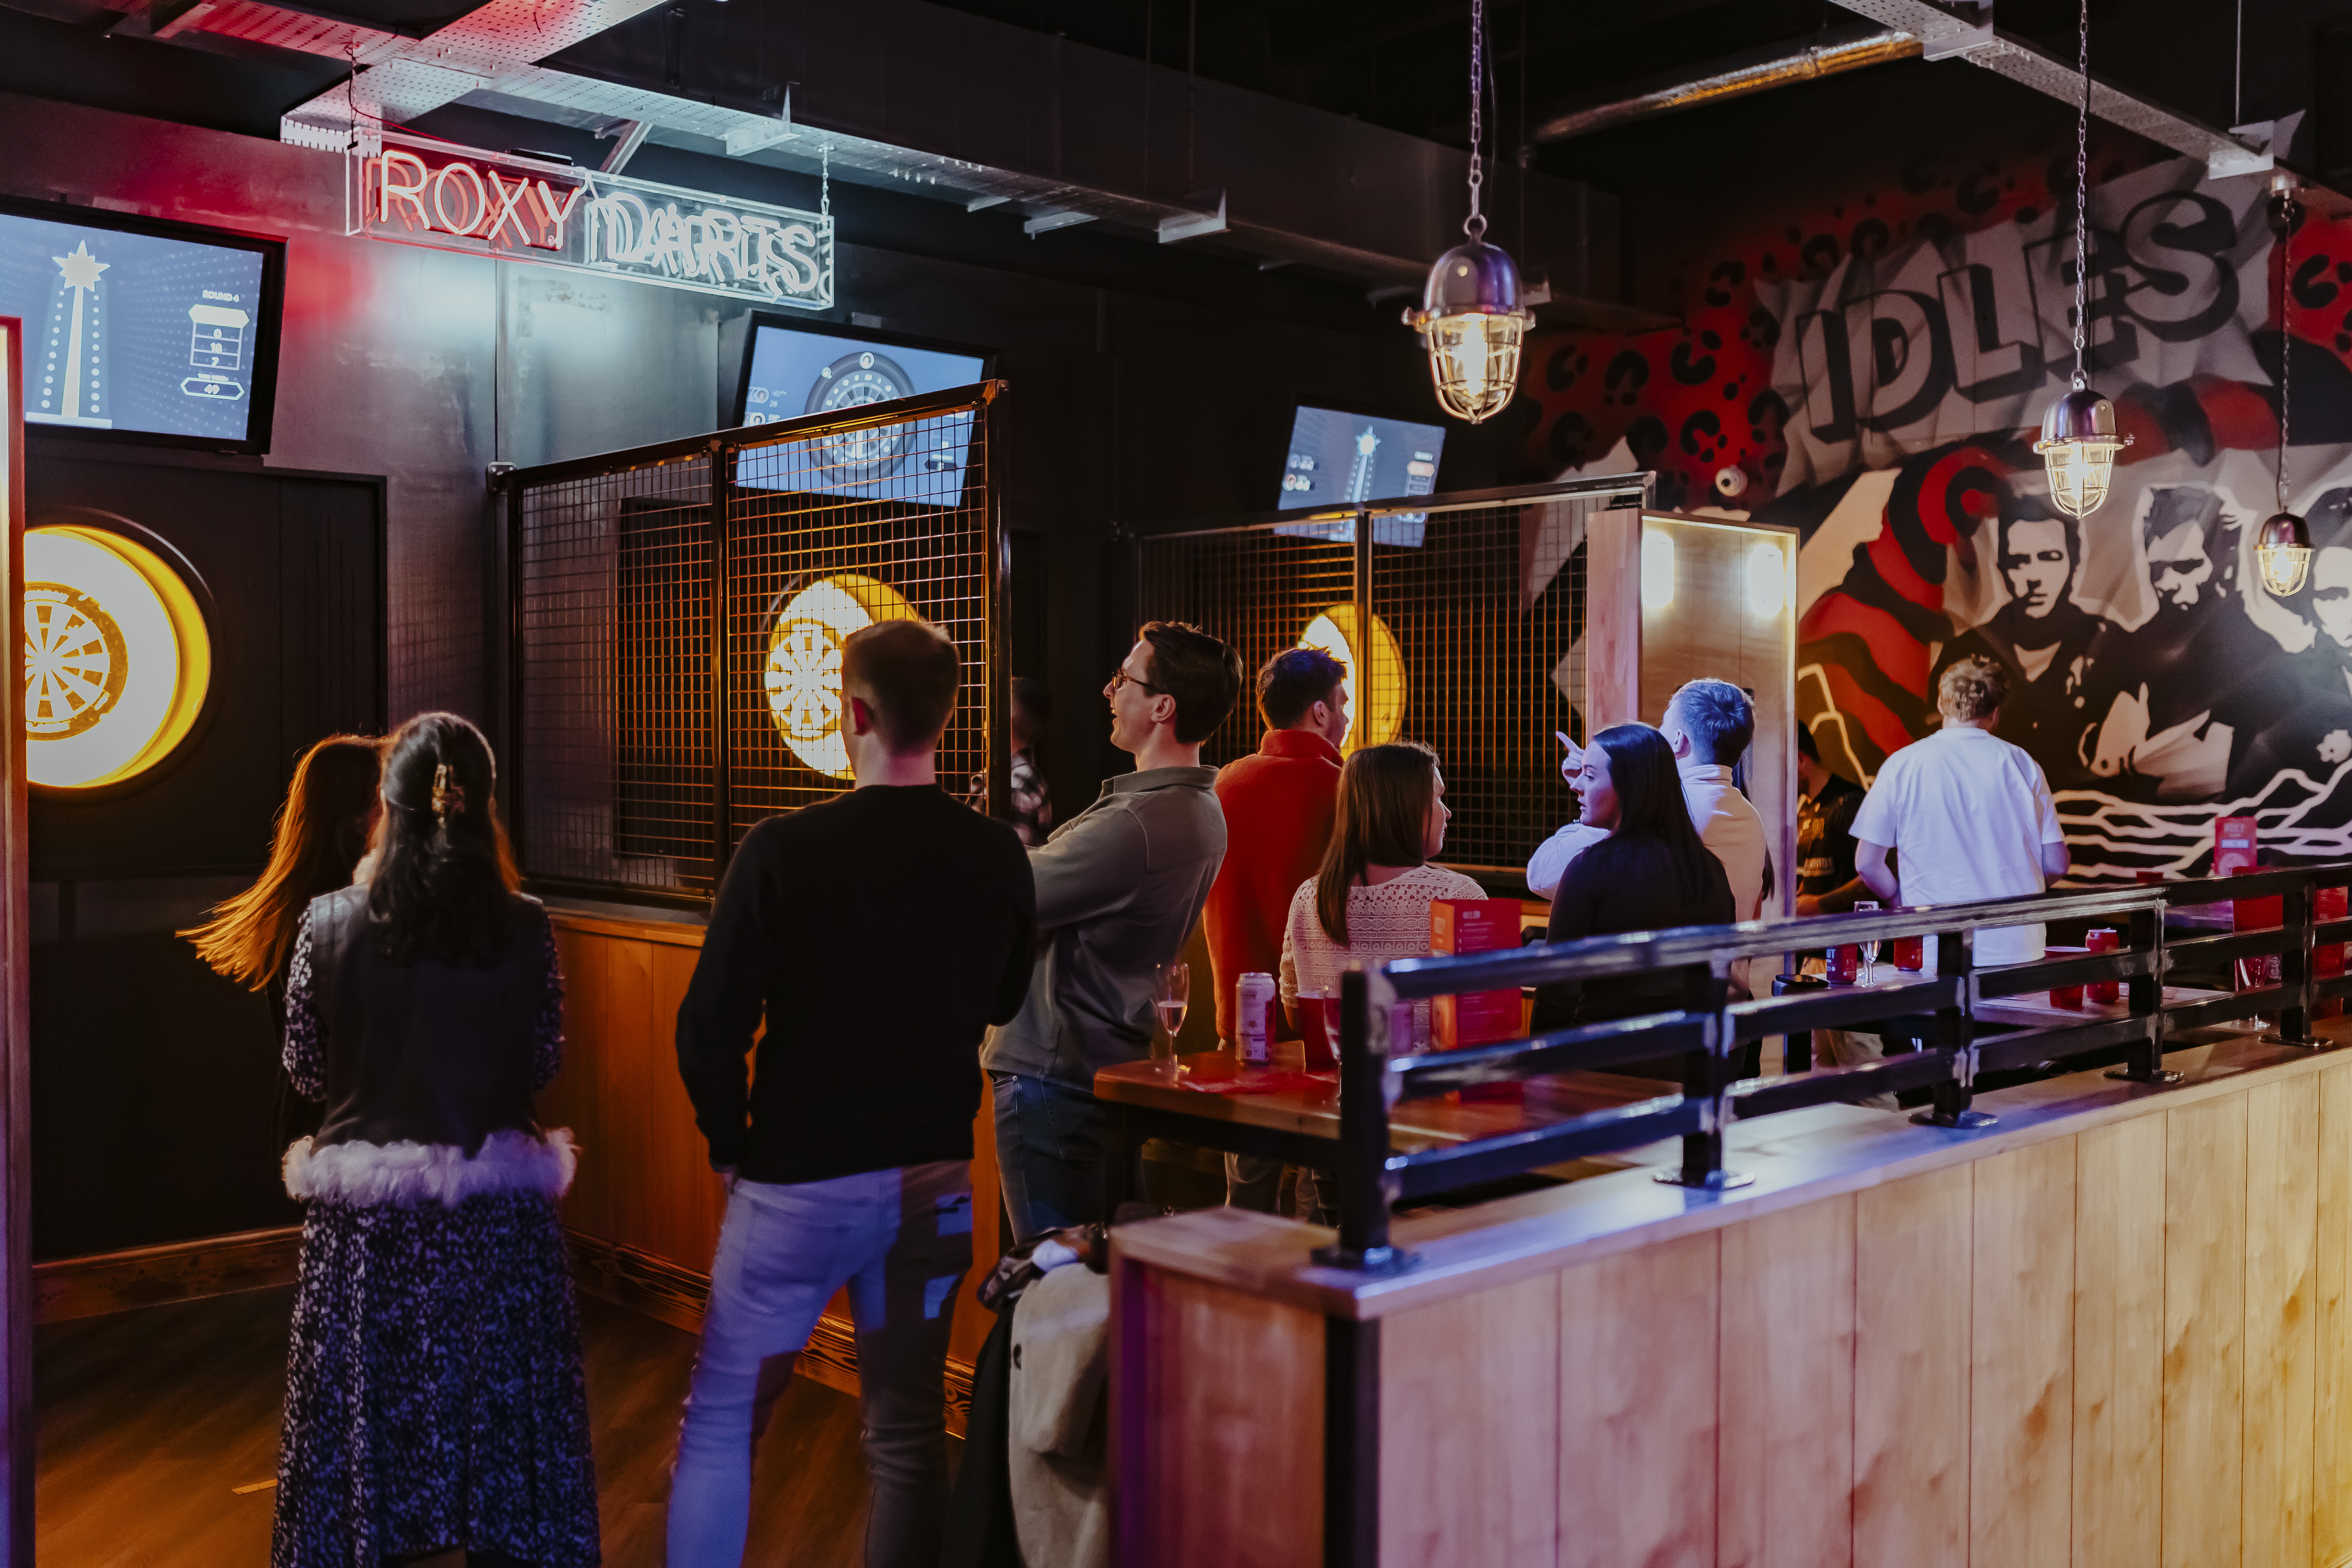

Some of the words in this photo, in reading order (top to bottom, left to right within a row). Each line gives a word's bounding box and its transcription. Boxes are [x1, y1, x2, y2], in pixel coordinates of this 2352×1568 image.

[378, 149, 581, 251] ROXY
[605, 190, 820, 293] DARTS
[202, 289, 233, 302] ROUND
[233, 294, 240, 303] 4
[1795, 189, 2240, 444] IDLES
[213, 328, 222, 339] 0
[210, 343, 223, 353] 18
[211, 357, 220, 367] 7
[204, 384, 220, 395] 49
